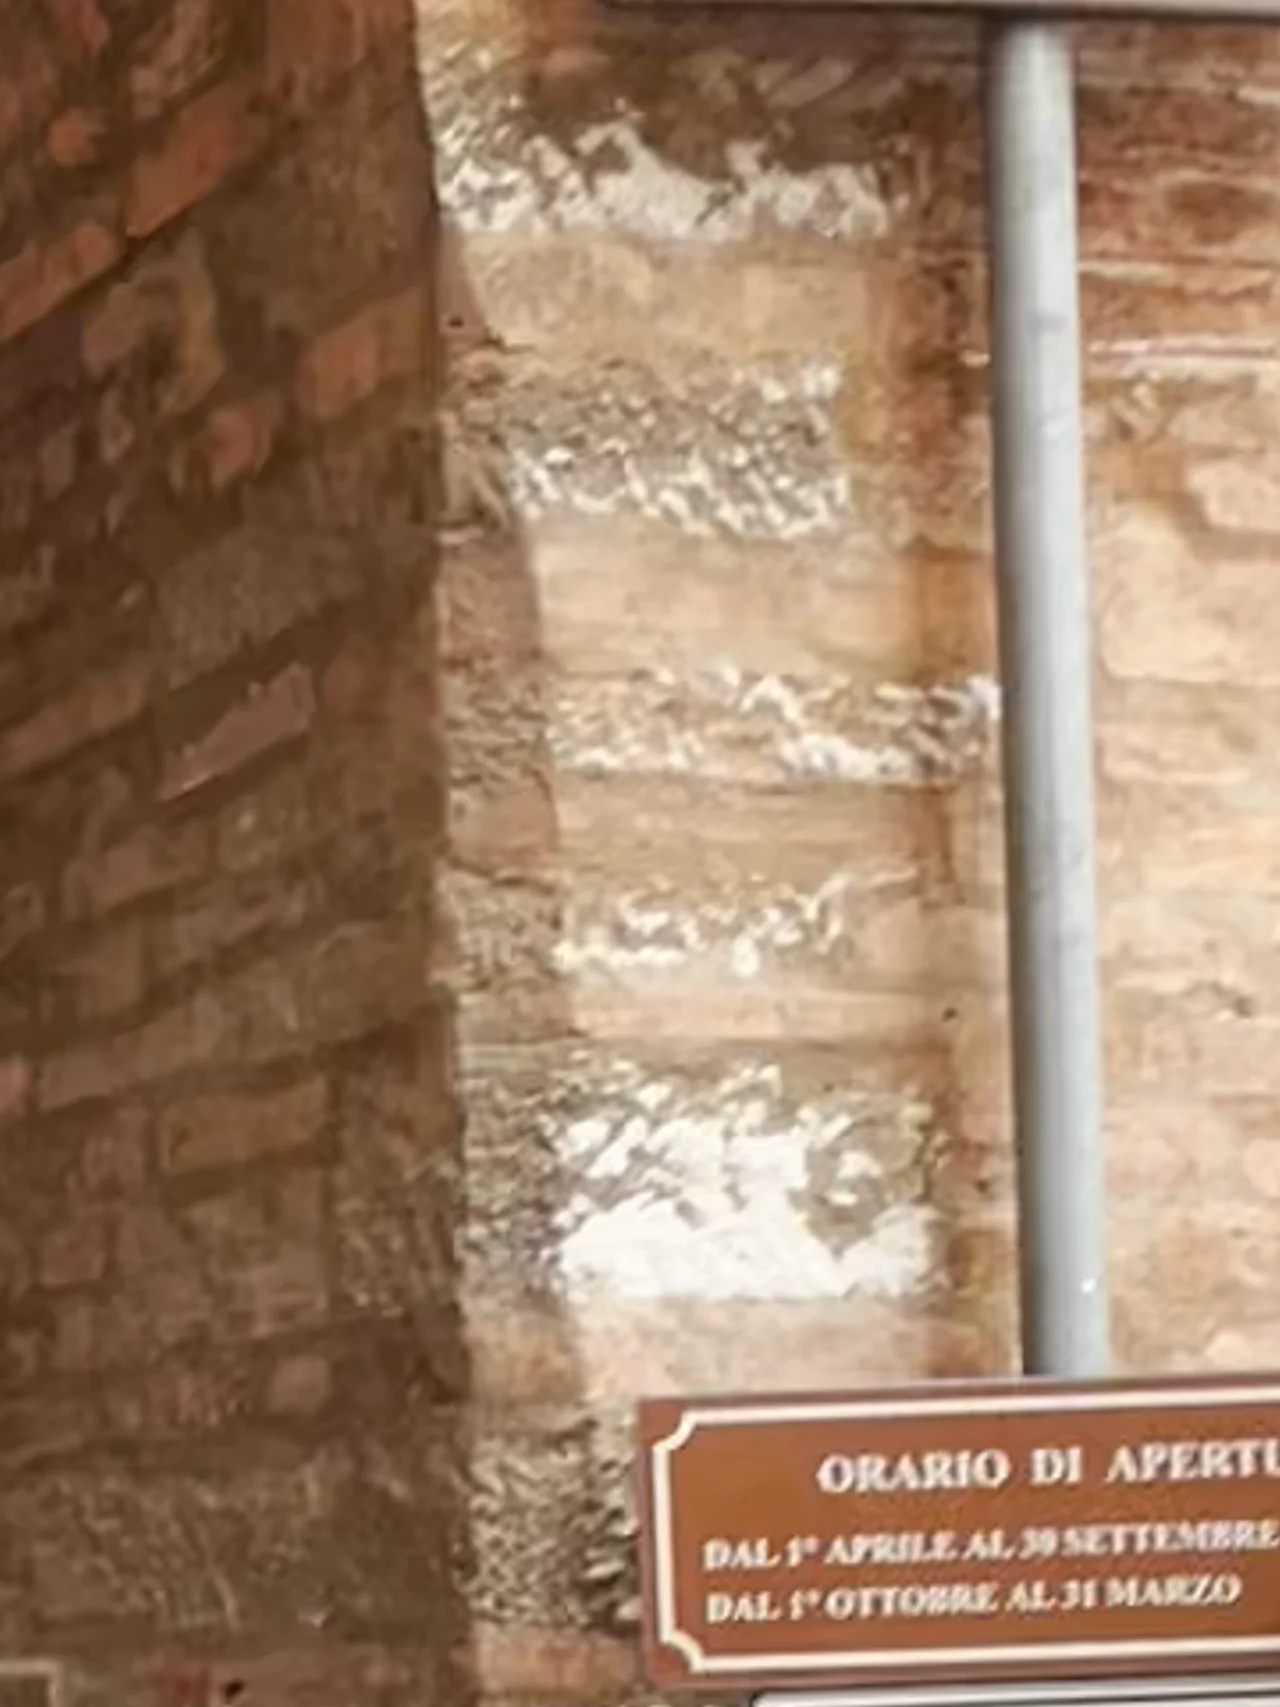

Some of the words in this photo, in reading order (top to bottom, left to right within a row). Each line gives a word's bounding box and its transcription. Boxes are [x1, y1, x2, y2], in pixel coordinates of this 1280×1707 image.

[817, 1448, 1012, 1493] ORARIO
[1030, 1445, 1083, 1485] DI
[703, 1538, 781, 1570] DAL
[825, 1529, 958, 1565] APRILE
[963, 1528, 1013, 1561] AL
[705, 1589, 781, 1624] DAL
[824, 1582, 998, 1618] OTTOBRE
[1004, 1579, 1057, 1612] AL
[1060, 1578, 1098, 1610] 31
[1104, 1570, 1244, 1607] MARZO
